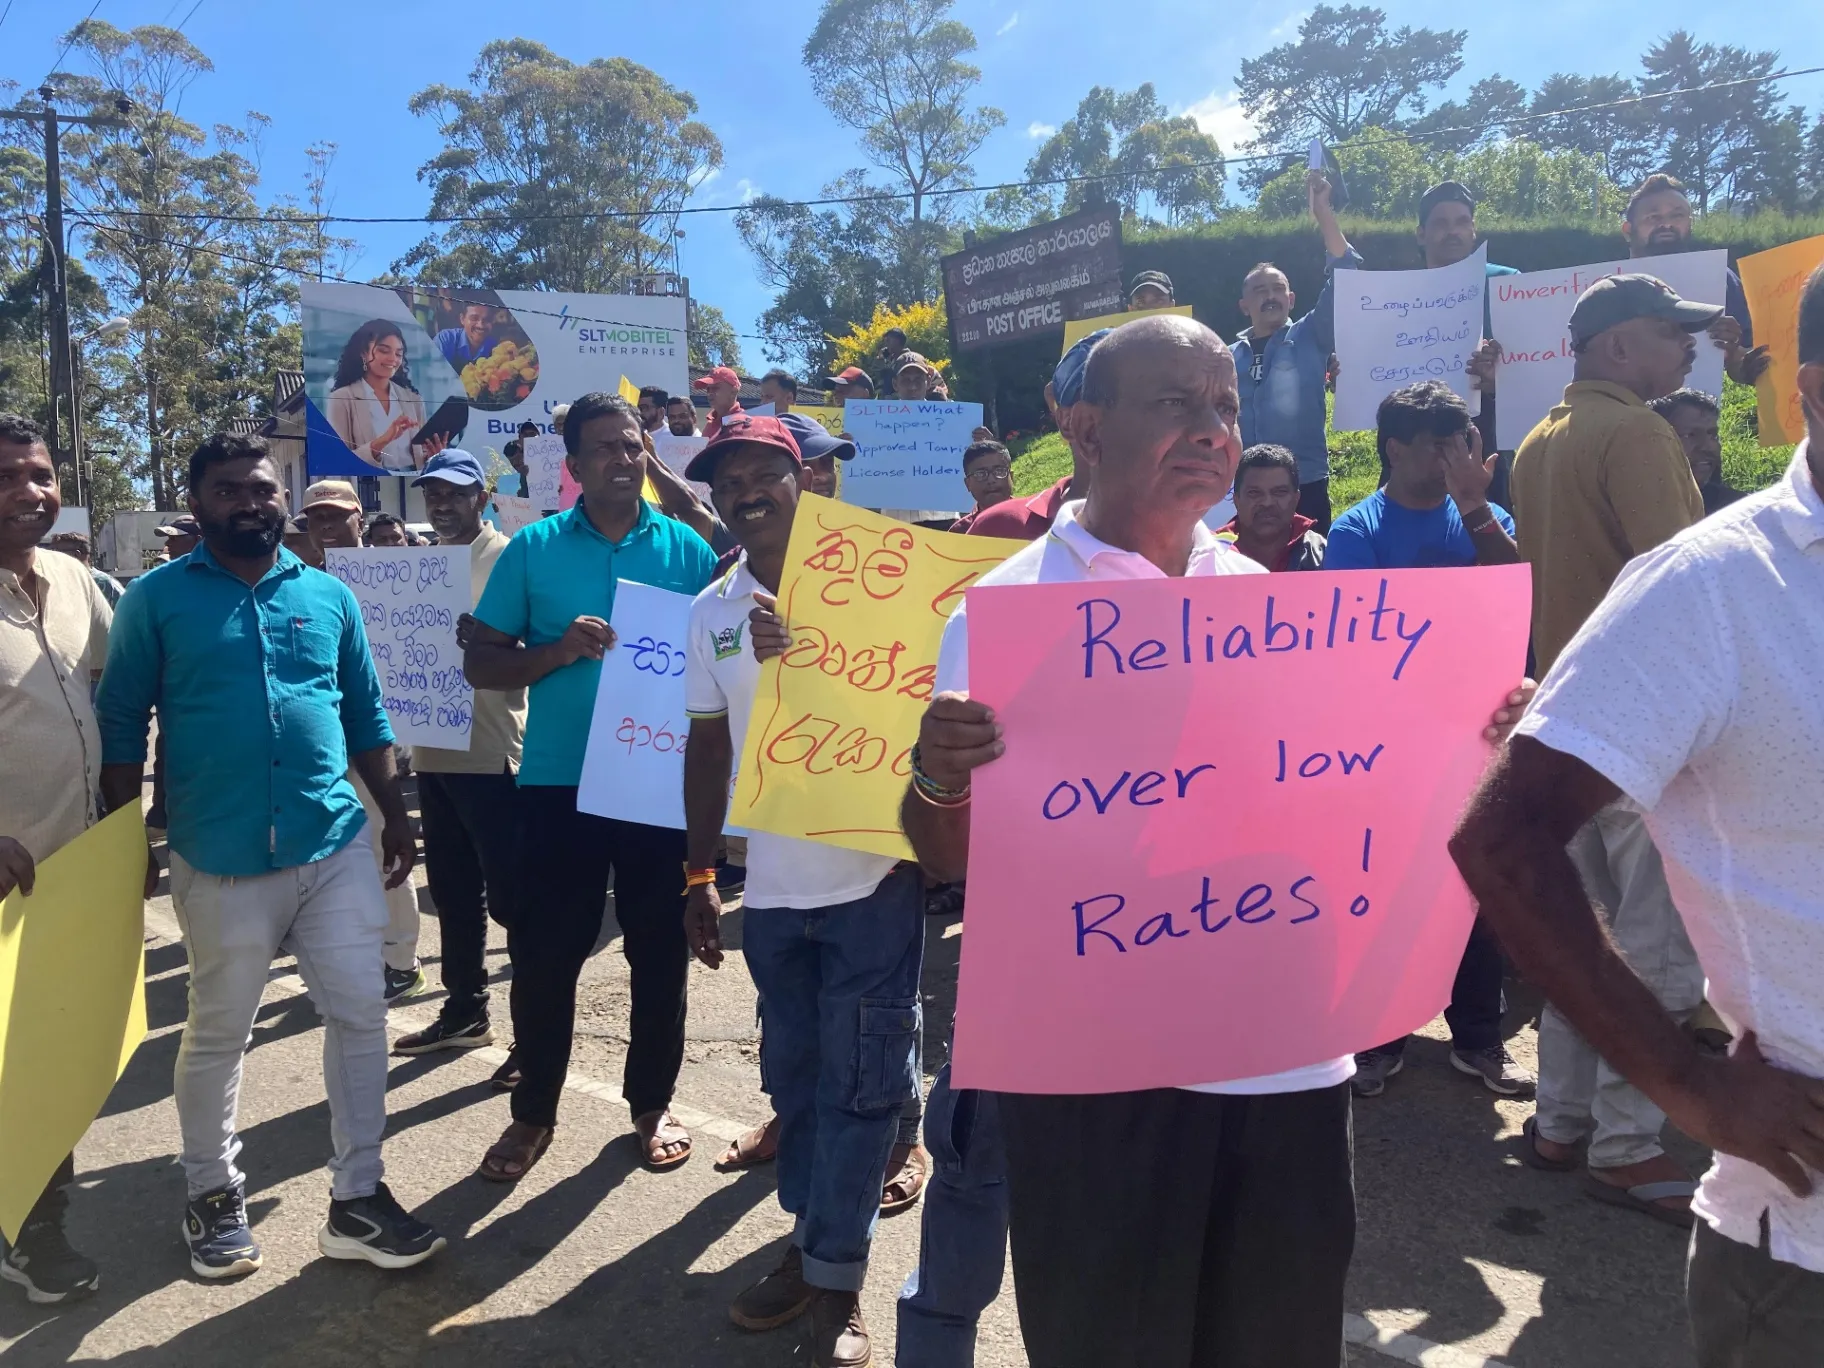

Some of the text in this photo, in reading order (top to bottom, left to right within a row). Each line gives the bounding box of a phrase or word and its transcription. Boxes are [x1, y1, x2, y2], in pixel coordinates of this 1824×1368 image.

[1498, 266, 1622, 301] Unverifi
[986, 301, 1062, 336] POST OFFICE
[579, 345, 676, 356] ENTERPRISE
[851, 403, 964, 416] SLTDA What
[855, 440, 917, 458] Approved
[804, 528, 914, 606] කුලී
[1076, 578, 1432, 680] Reliability
[1042, 739, 1385, 821] over low
